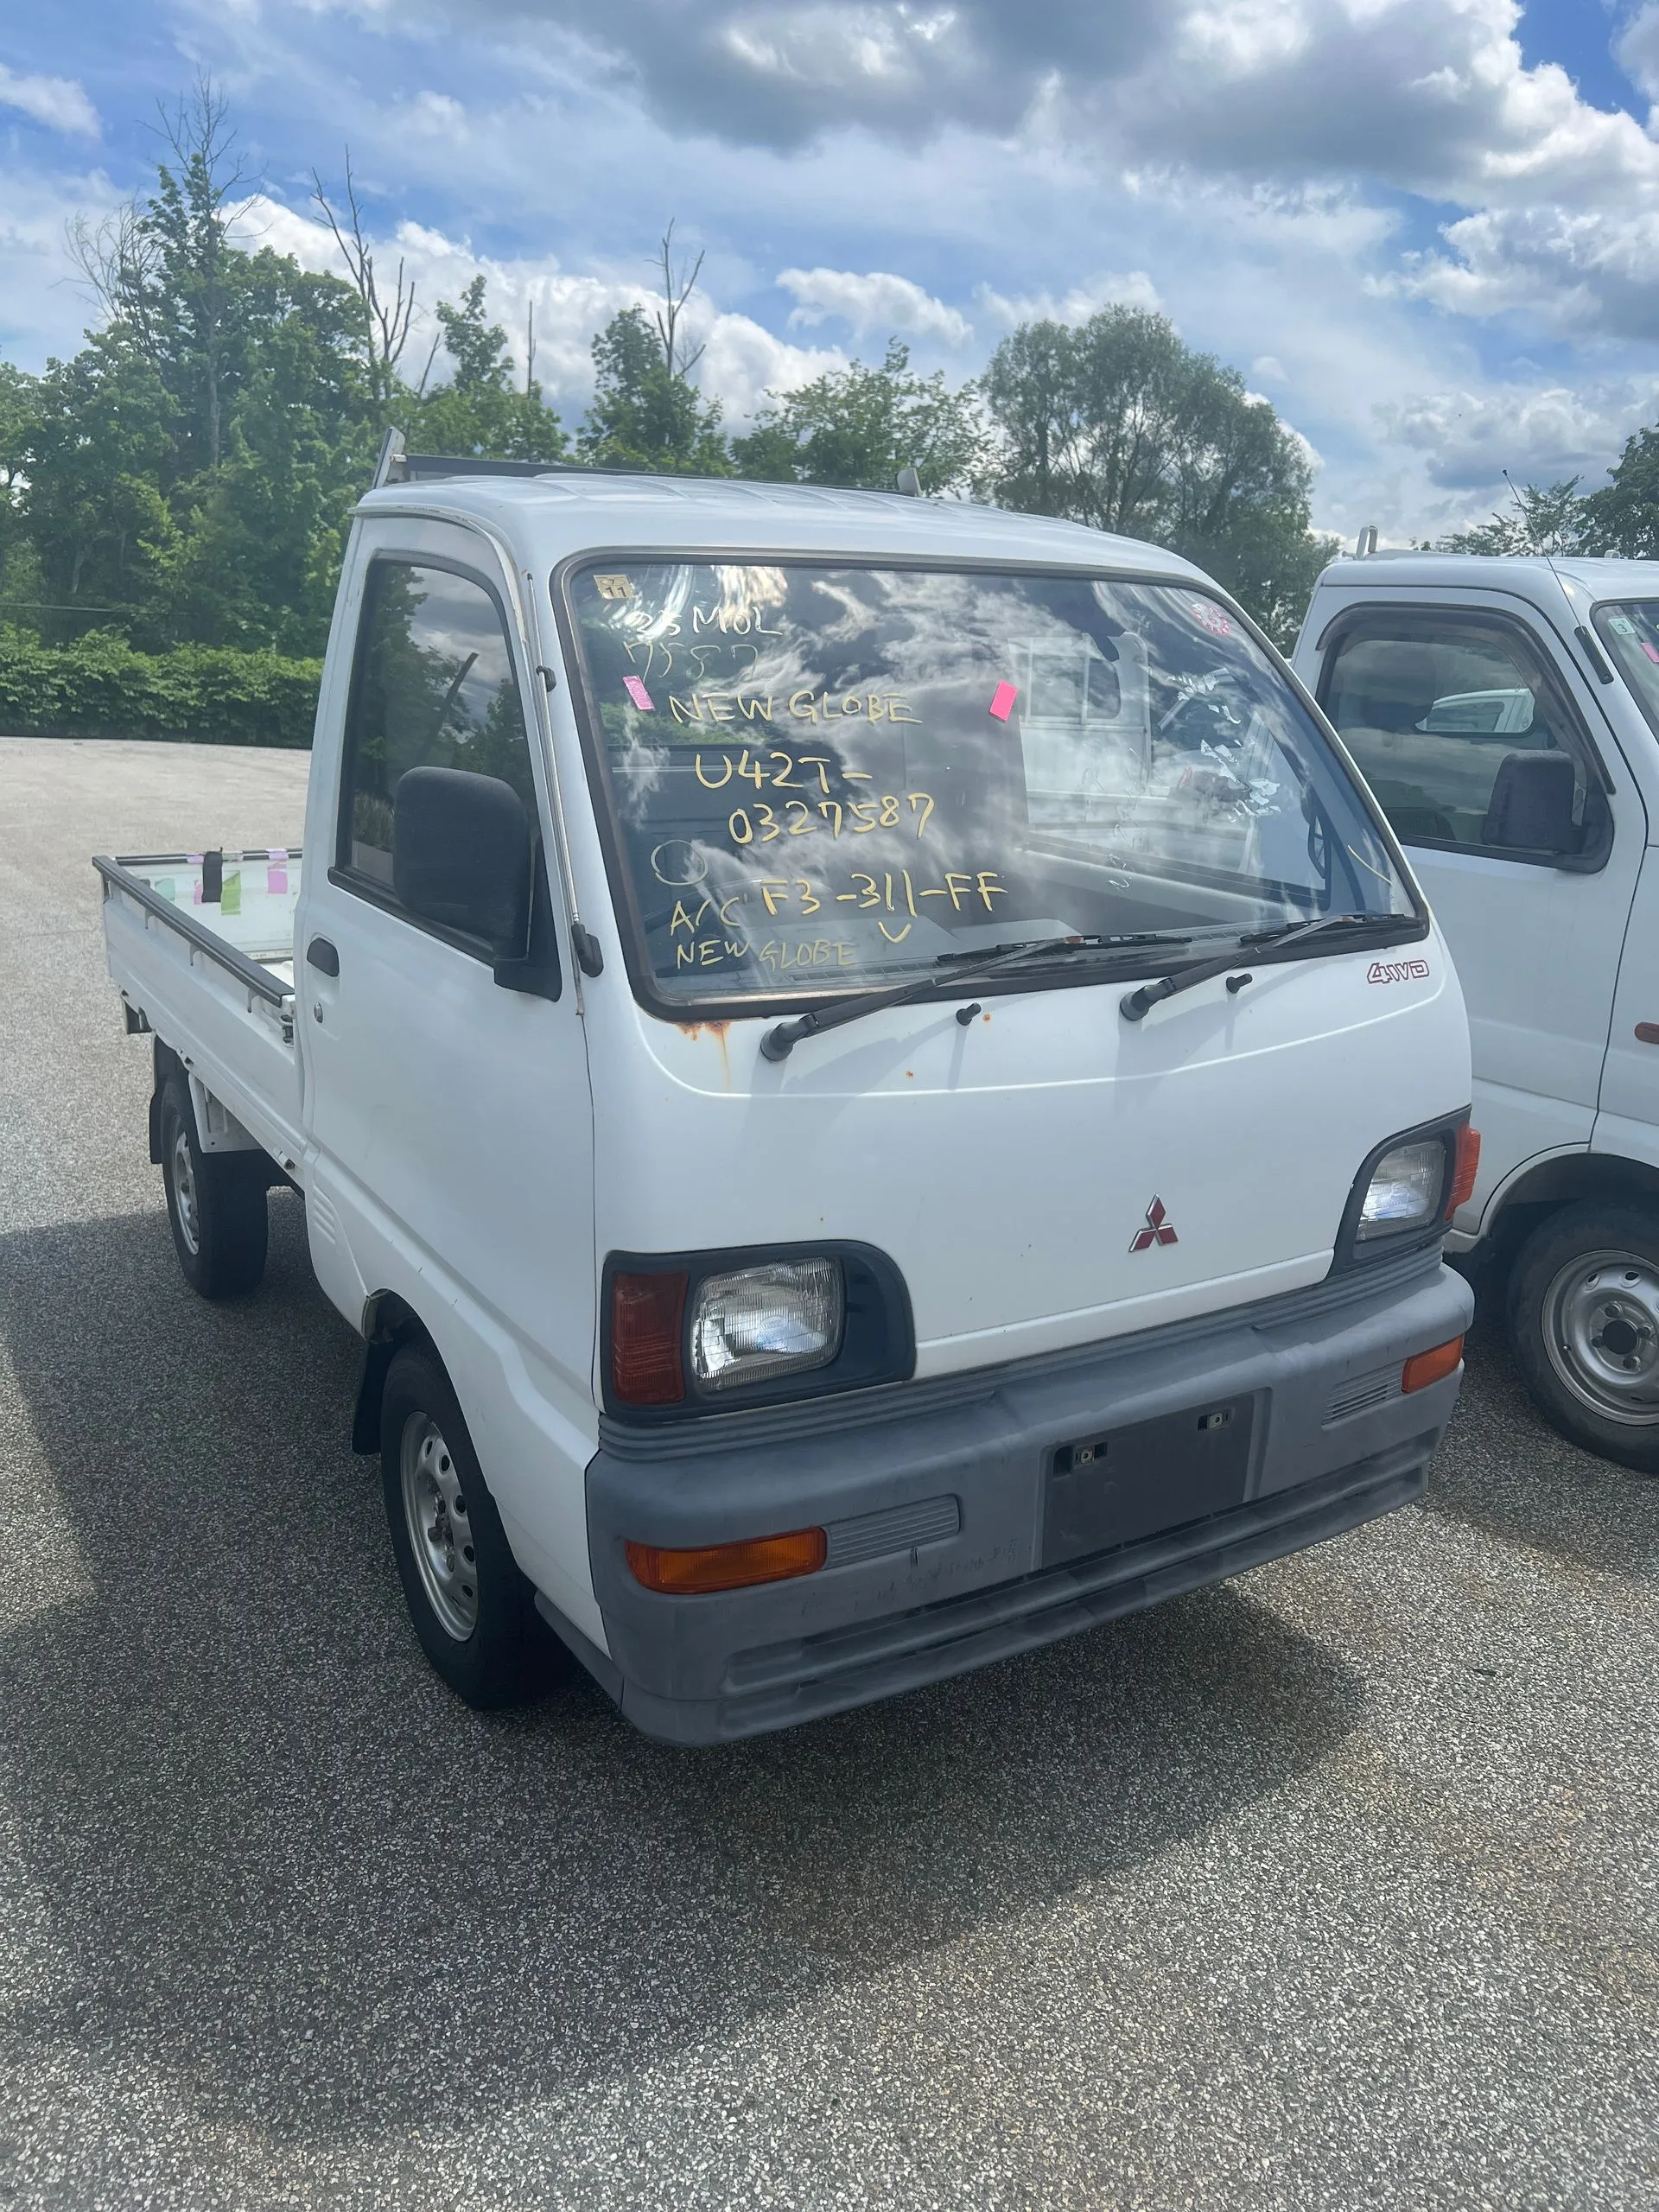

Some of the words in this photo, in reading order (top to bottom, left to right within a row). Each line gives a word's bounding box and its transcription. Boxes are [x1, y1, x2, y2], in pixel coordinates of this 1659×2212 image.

[605, 586, 627, 598] 11
[693, 606, 783, 635] MOL
[1617, 623, 1628, 633] 3
[669, 692, 772, 723] NEW
[788, 690, 923, 724] GLOBE
[728, 792, 935, 844] 0327587
[671, 896, 742, 935] A/C
[677, 939, 750, 969] NEW
[760, 939, 860, 971] GLOBE
[1367, 960, 1430, 984] 4WD
